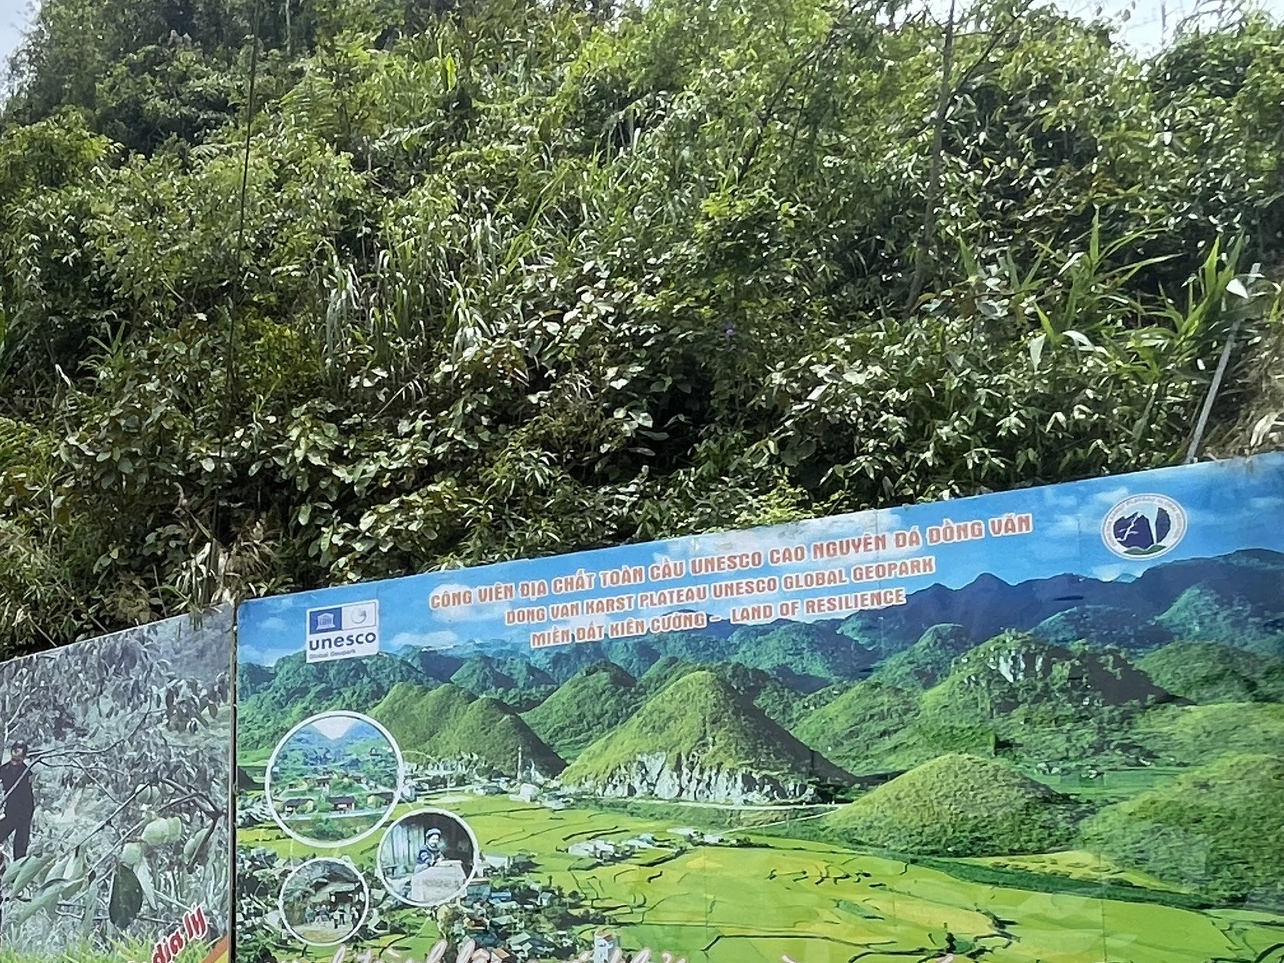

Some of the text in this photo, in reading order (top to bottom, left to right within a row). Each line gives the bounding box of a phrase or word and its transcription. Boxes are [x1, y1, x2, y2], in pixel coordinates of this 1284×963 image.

[430, 589, 472, 609] CÔNG
[478, 582, 514, 603] VIÊN
[520, 579, 547, 600] ĐỊA
[553, 569, 595, 593] CHẤT
[601, 564, 643, 588] TOÀN
[650, 556, 684, 580] CẦU
[691, 551, 762, 575] UNESCO
[769, 545, 806, 565] CAO
[812, 533, 886, 560] NGUYÊN
[894, 526, 921, 549] ĐÁ
[928, 518, 983, 545] ĐỒNG
[506, 557, 934, 624] DONG VAN KARST PLATEAU UNESCO GLOBAL GEOPARK
[309, 632, 376, 651] unesco
[531, 627, 570, 648] MIỀN
[609, 614, 645, 637] KIÊN
[731, 604, 773, 623] LAND
[780, 601, 799, 618] OF
[805, 588, 905, 614] RESILIENCE
[182, 902, 209, 941] lý
